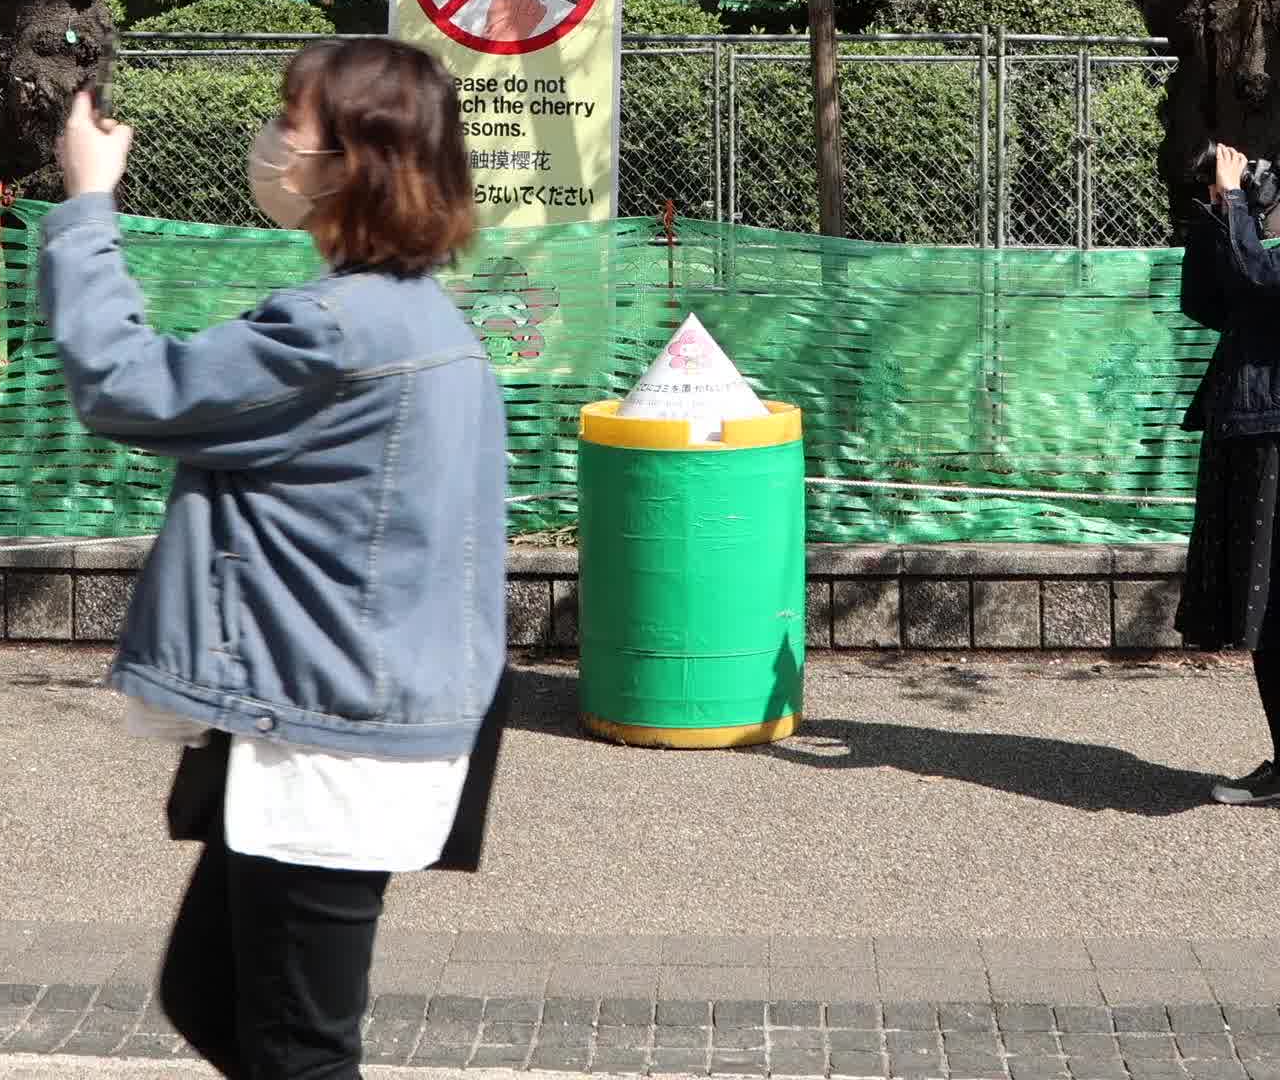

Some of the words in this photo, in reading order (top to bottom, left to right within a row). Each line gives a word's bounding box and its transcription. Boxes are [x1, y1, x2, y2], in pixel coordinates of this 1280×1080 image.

[453, 77, 498, 93] ease
[504, 75, 528, 93] do
[534, 76, 566, 94] not
[493, 96, 524, 114] the
[530, 97, 595, 118] cherry
[470, 150, 552, 170] 触摸樱花
[474, 184, 595, 206] らないでください
